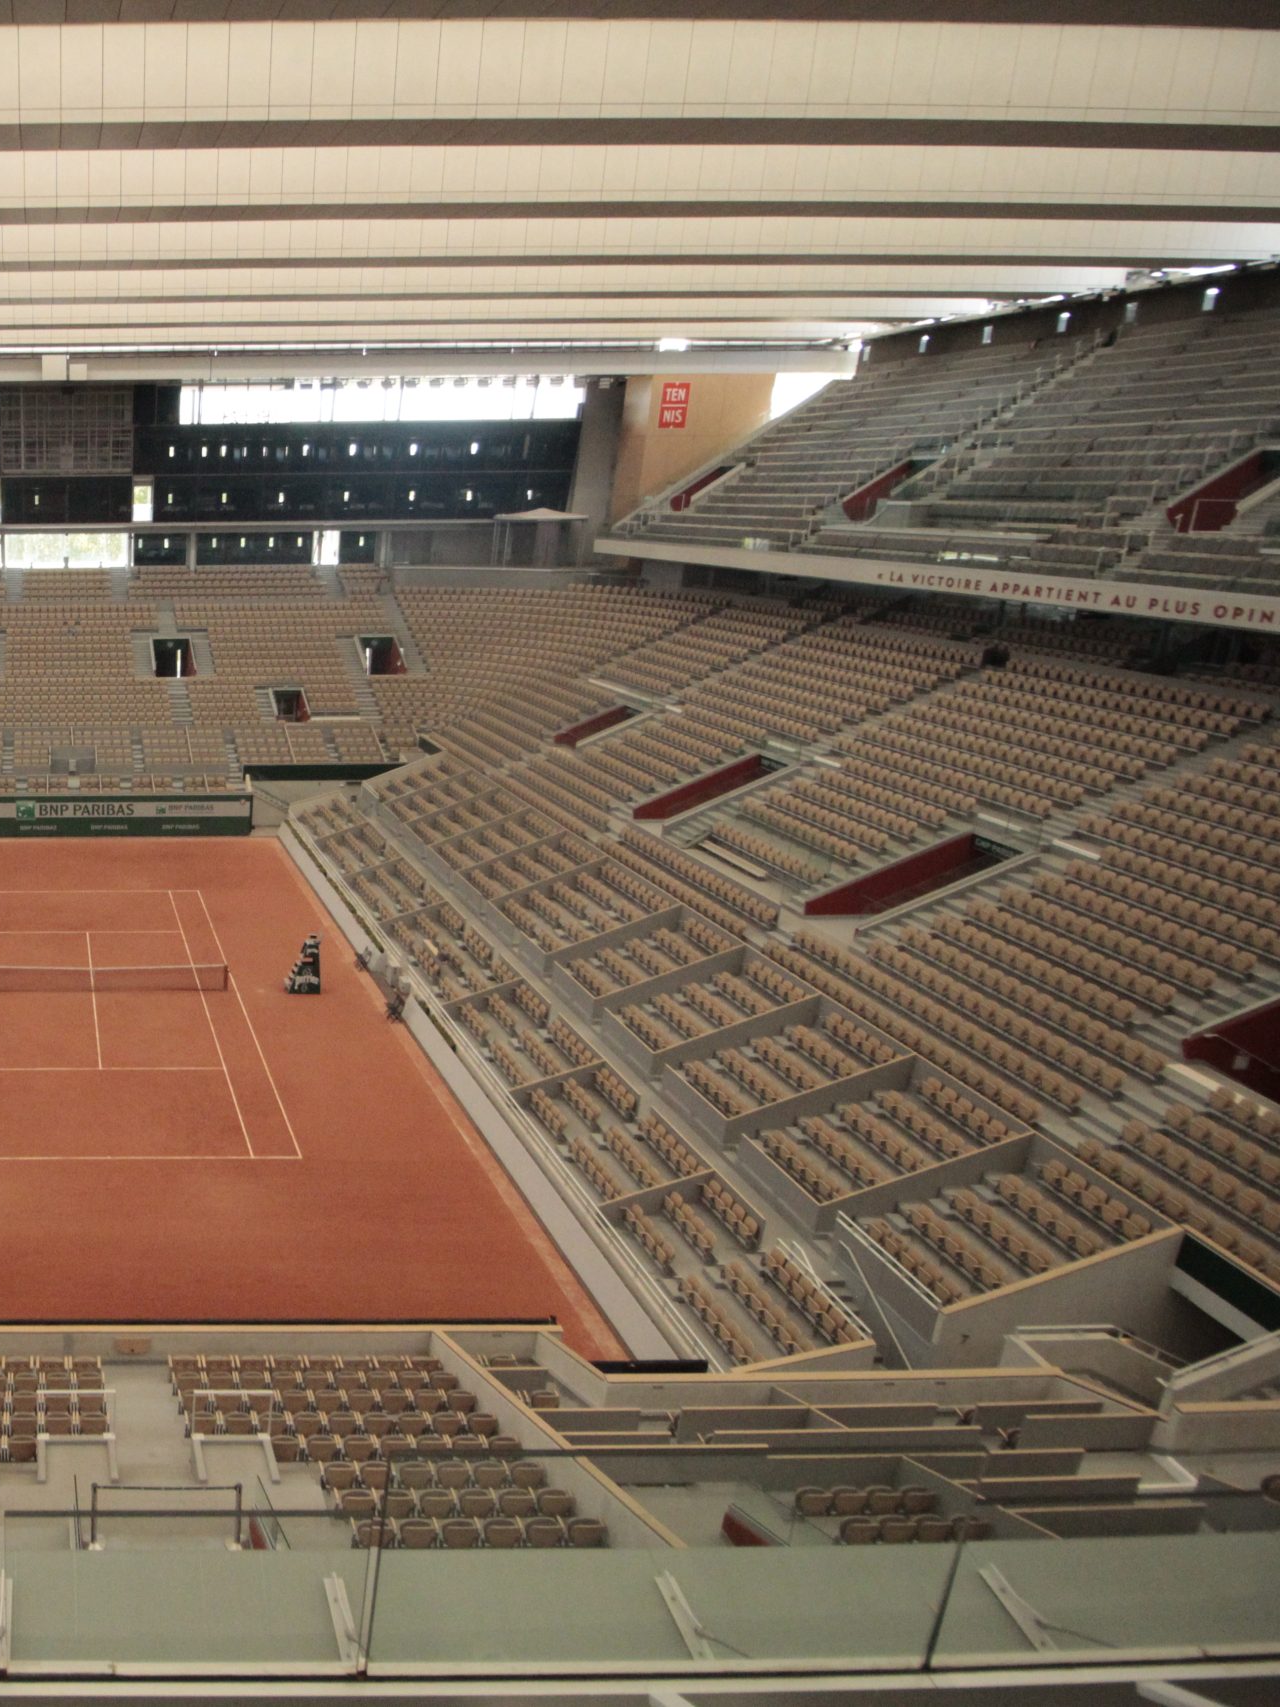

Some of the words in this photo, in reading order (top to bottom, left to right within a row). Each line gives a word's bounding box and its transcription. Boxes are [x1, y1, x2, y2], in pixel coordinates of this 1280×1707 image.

[666, 388, 687, 401] TEN
[662, 409, 683, 423] NIS
[889, 571, 904, 583] LA
[911, 574, 983, 591] VICTOIRE
[989, 582, 1102, 604] APPARTIENT
[1110, 595, 1137, 609] AU
[1148, 598, 1201, 616] PLUS
[1213, 605, 1280, 626] OPIN
[39, 804, 69, 817] BNP
[72, 804, 135, 817] PARIBAS
